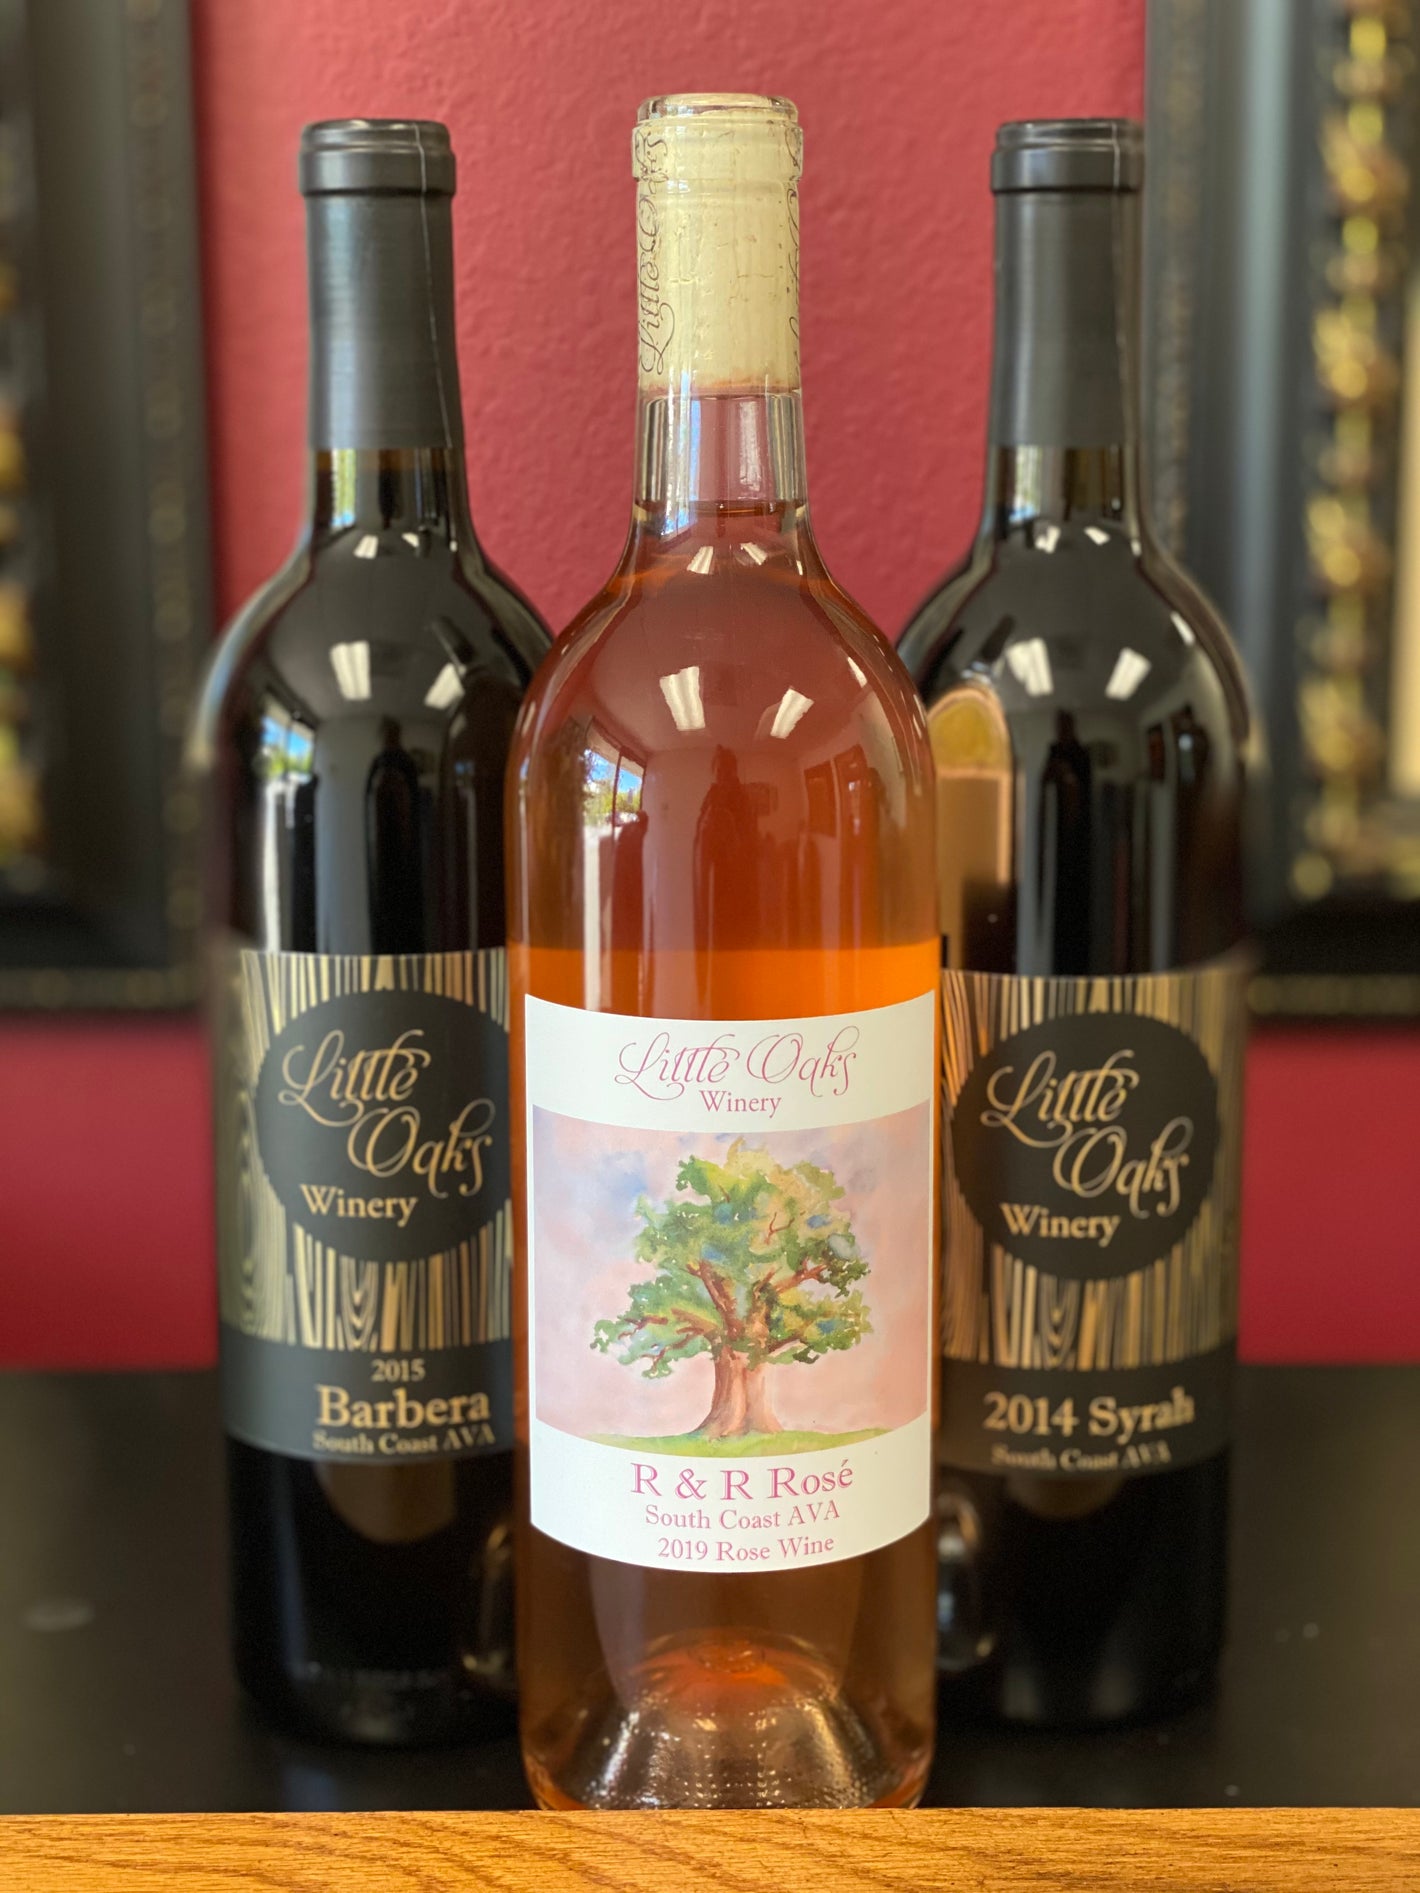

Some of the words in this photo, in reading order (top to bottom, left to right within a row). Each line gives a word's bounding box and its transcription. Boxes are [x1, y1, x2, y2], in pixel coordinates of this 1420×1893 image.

[278, 1029, 431, 1127] Little
[614, 1031, 740, 1100] Little
[746, 1025, 860, 1098] Oaks
[699, 1090, 782, 1118] Winery
[980, 1049, 1140, 1148] Little
[347, 1098, 496, 1199] Oaks
[1052, 1115, 1194, 1219] Oaks
[300, 1184, 418, 1227] Winery
[1001, 1202, 1120, 1247] Winery
[371, 1358, 425, 1382] 2015
[317, 1384, 490, 1429] Barbera
[983, 1391, 1079, 1437] 2014
[1088, 1386, 1196, 1445] Syrah
[312, 1429, 374, 1454] South
[379, 1432, 437, 1454] Coast
[444, 1423, 496, 1450] AVA
[631, 1462, 662, 1496] R
[675, 1468, 707, 1500] &
[720, 1469, 753, 1500] R
[767, 1459, 854, 1498] Rosé
[645, 1504, 711, 1529] South
[719, 1509, 781, 1530] Coast
[787, 1500, 840, 1526] AVA
[658, 1537, 708, 1560] 2019
[715, 1541, 770, 1561] Rose
[777, 1537, 835, 1557] Wine
